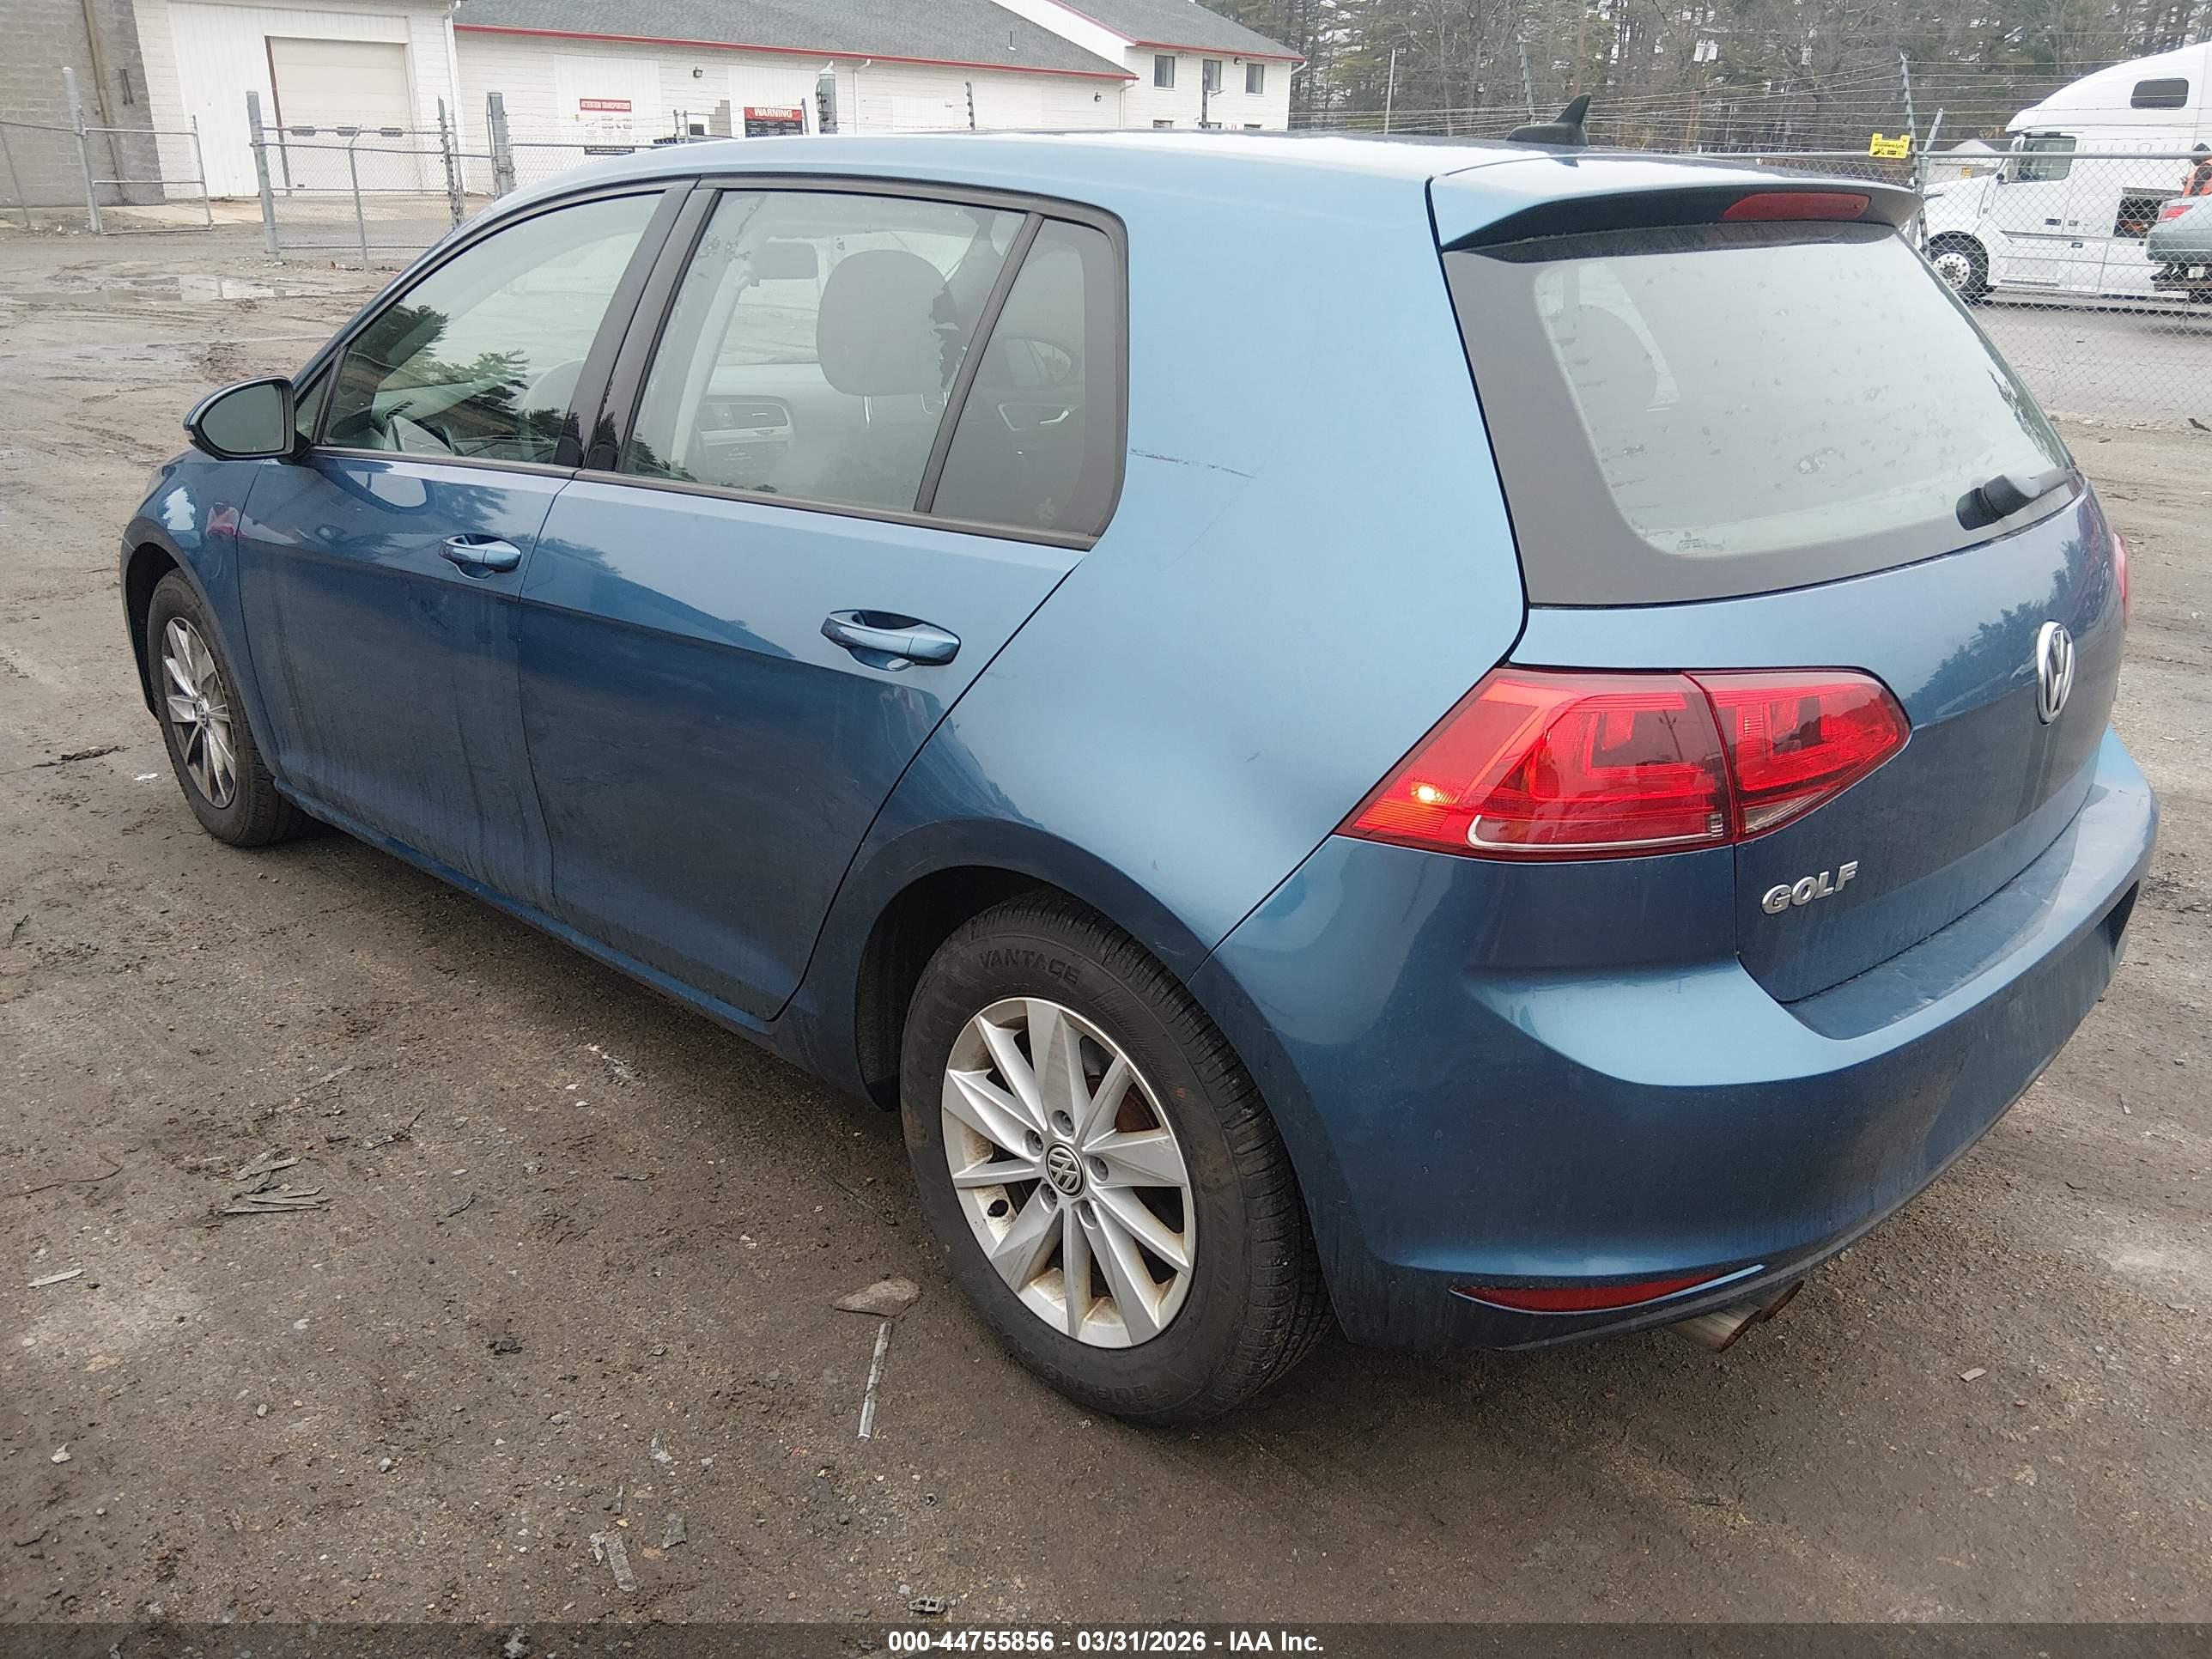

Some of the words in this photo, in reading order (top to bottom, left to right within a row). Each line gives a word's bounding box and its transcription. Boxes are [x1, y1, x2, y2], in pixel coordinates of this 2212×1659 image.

[754, 107, 793, 118] WARNING
[1761, 860, 1858, 915] GOLF
[980, 948, 1079, 985] VANTAGE
